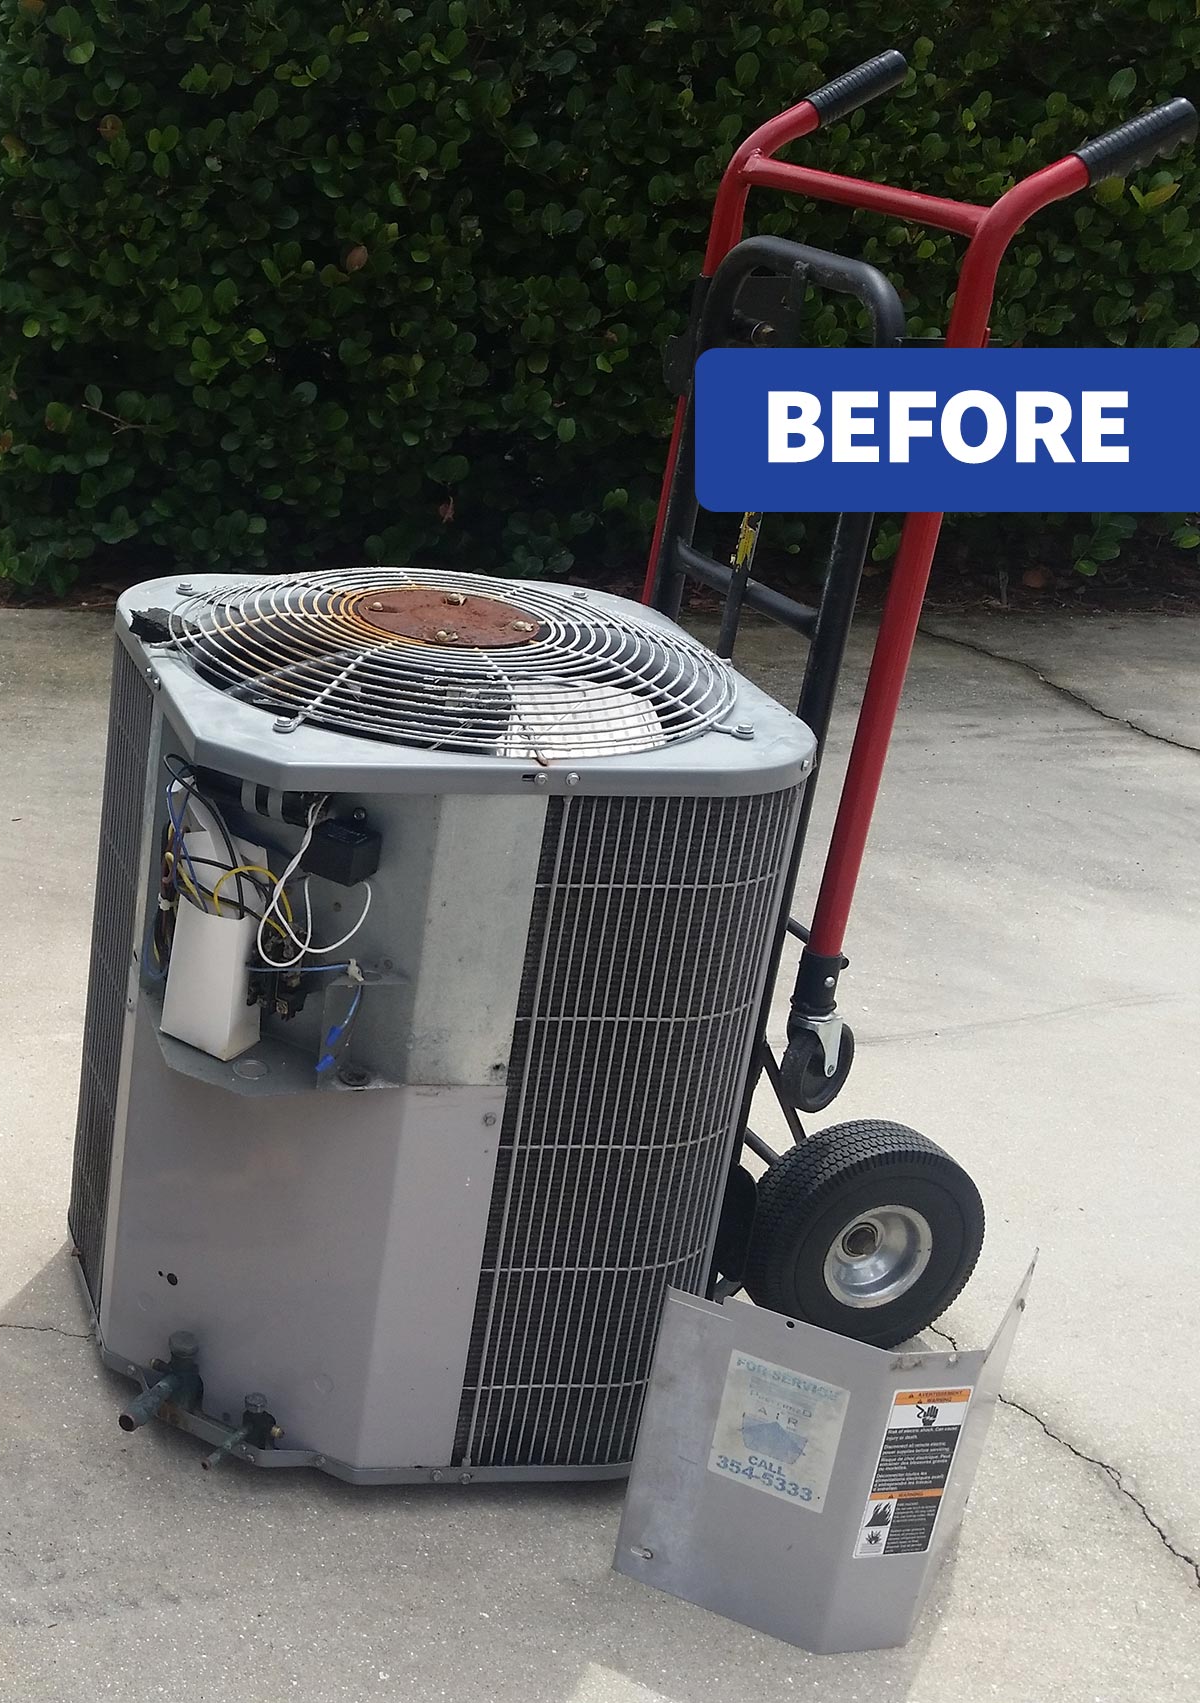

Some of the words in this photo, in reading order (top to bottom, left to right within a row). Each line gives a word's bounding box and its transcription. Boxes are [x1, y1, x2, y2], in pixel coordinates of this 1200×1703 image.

[737, 1358, 767, 1376] FOR
[772, 1370, 842, 1400] SERVICE
[716, 1455, 812, 1502] 354-5333
[748, 1456, 786, 1477] CALL
